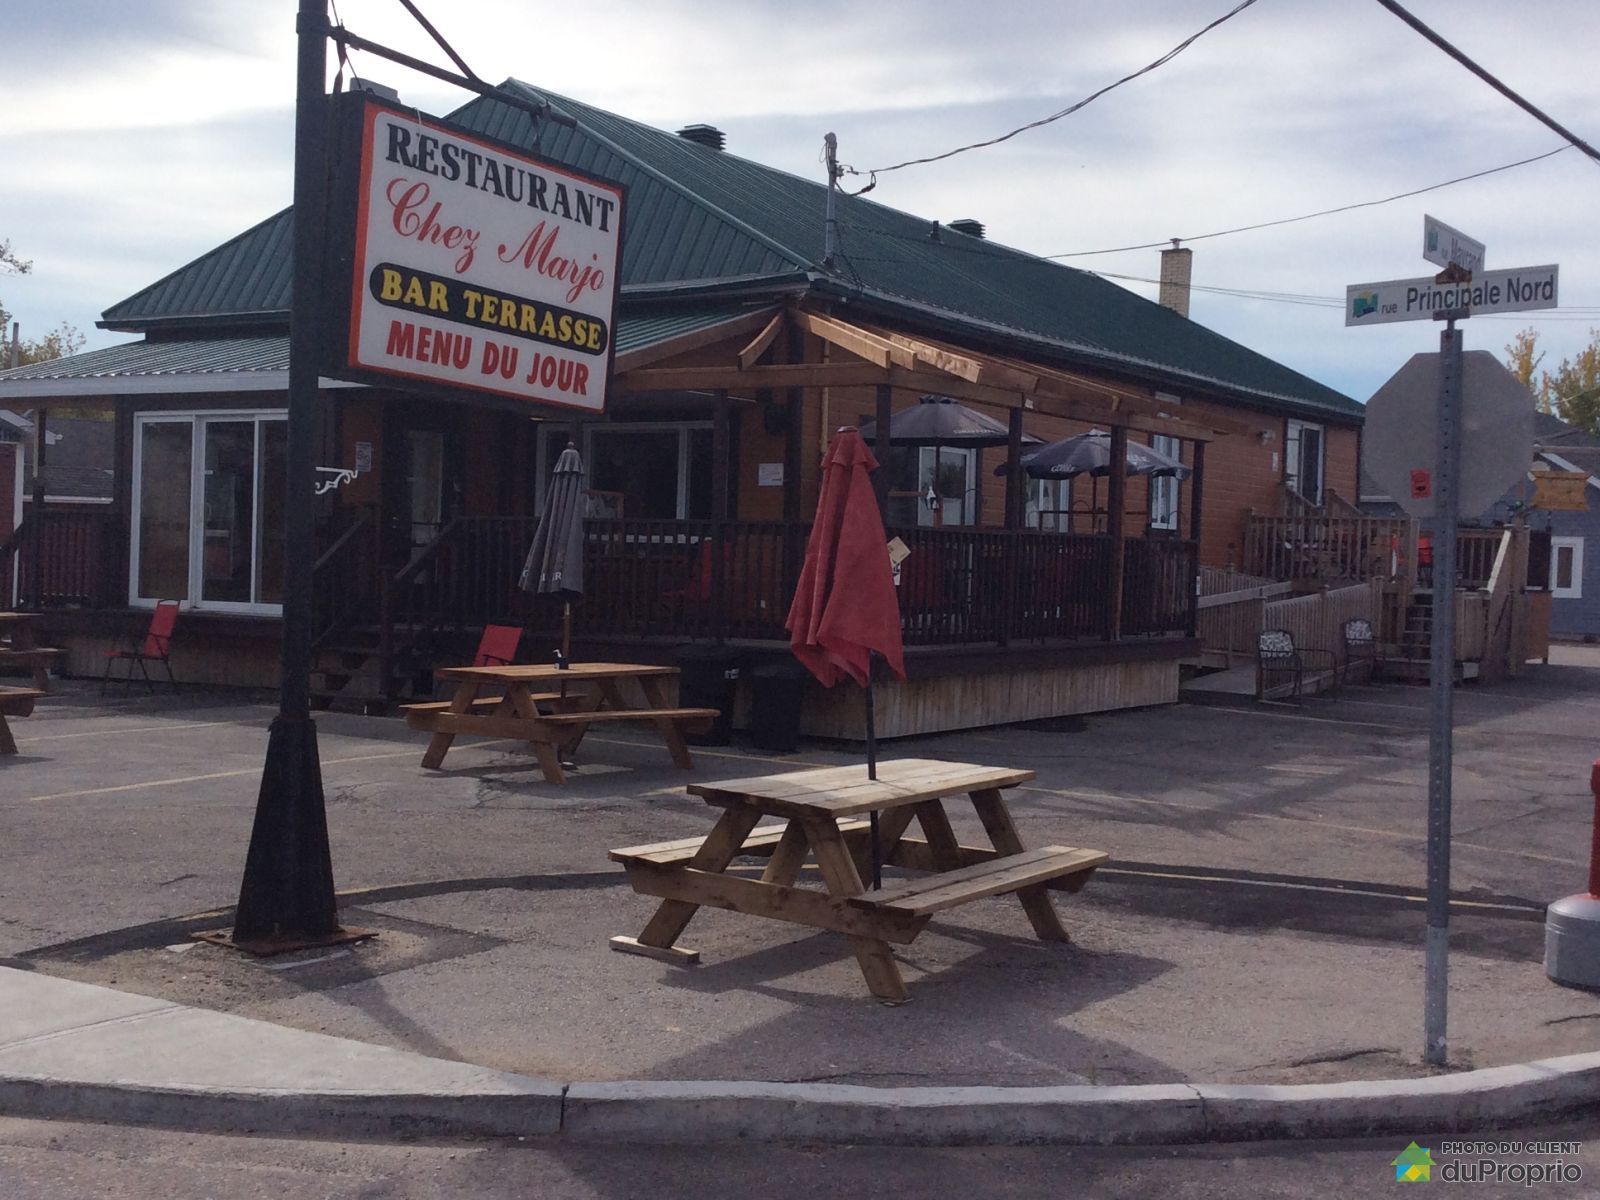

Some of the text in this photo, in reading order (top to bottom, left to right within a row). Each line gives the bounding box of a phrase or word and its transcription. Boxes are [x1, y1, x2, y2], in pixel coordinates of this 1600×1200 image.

[386, 123, 614, 233] RESTAURANT
[386, 178, 605, 304] Chez Marjo
[380, 269, 602, 350] BAR TERRASSE
[1381, 274, 1554, 315] rue Principale Nord
[386, 320, 589, 396] MENU DU JOUR
